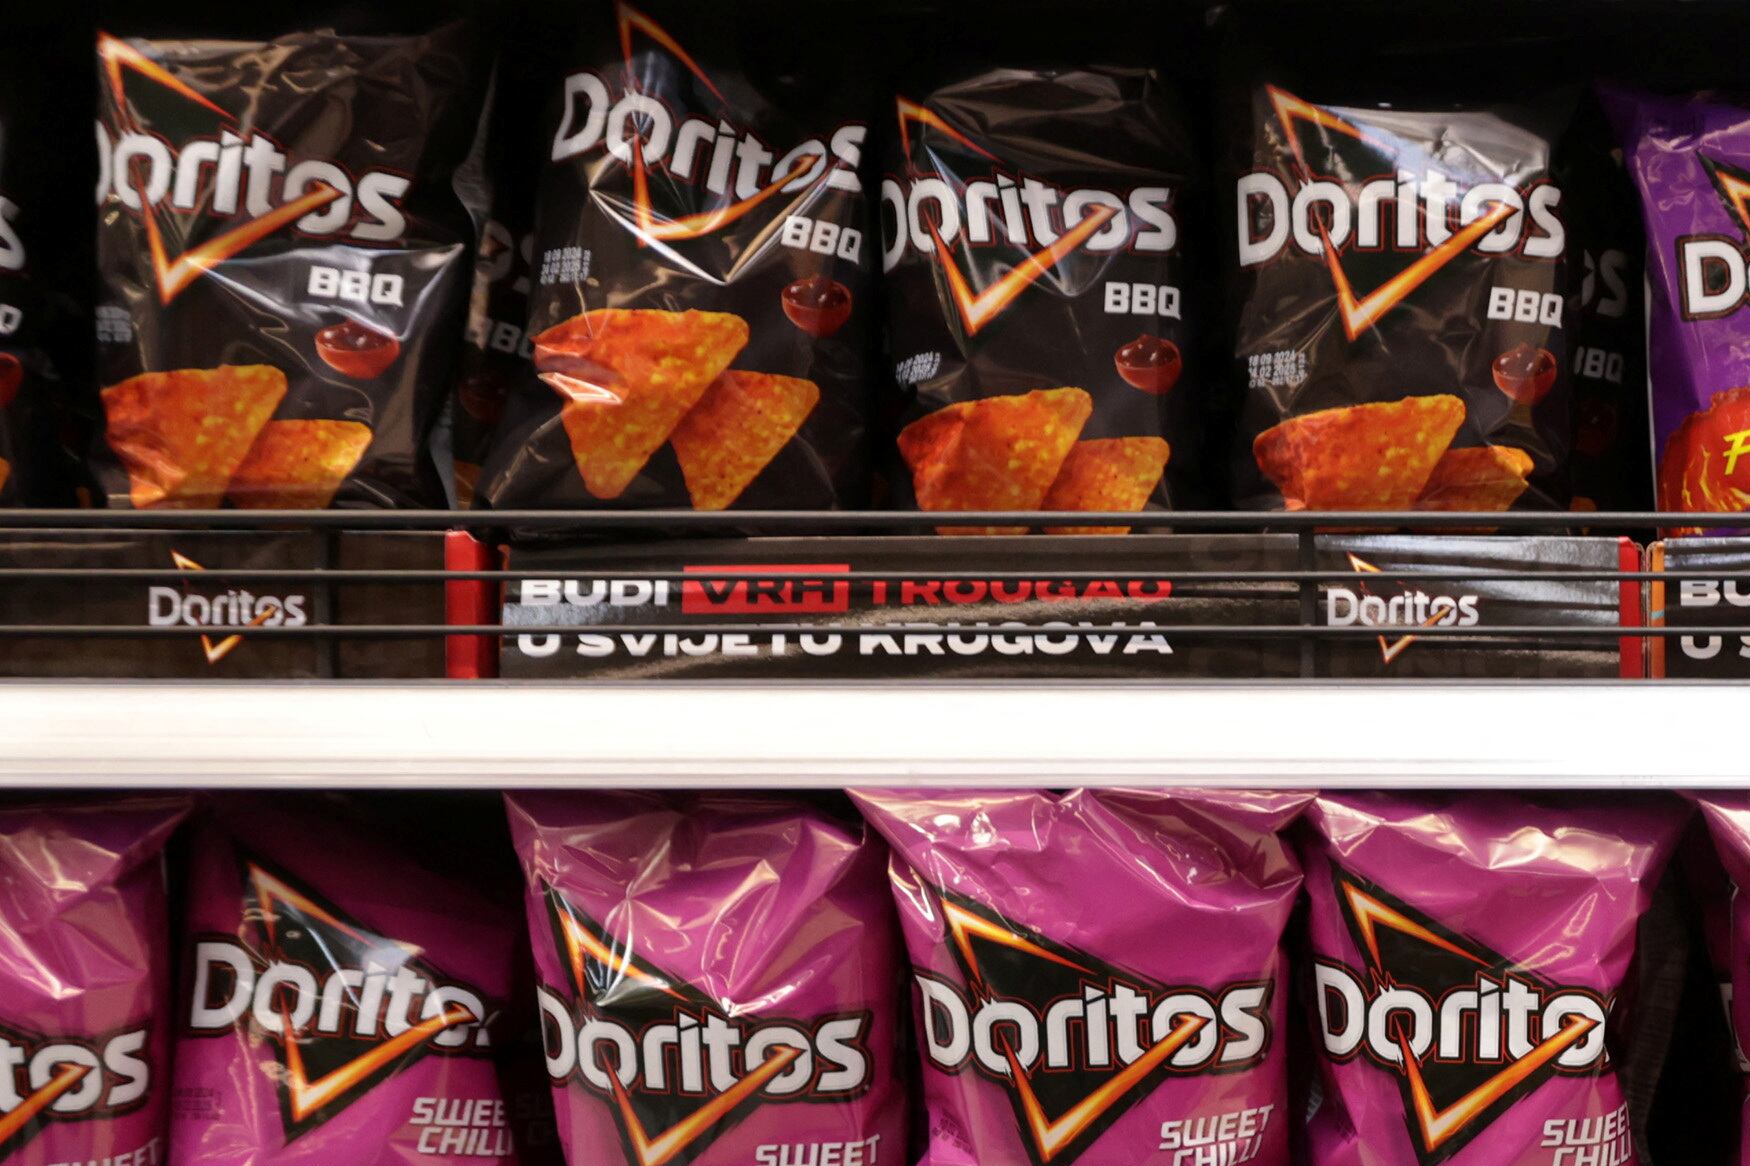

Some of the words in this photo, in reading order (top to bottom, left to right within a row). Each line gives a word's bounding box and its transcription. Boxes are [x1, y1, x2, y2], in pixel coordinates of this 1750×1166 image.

[552, 70, 867, 197] Doritos
[97, 122, 410, 241] oritos
[1239, 169, 1565, 268] Doritos
[782, 216, 862, 264] BBQ
[309, 266, 404, 306] BBQ
[1105, 283, 1181, 320] BBQ
[1487, 287, 1563, 329] BBQ
[148, 586, 306, 627] Doritos
[520, 578, 668, 606] BUDI
[862, 580, 1172, 604] TROUGAO
[1326, 588, 1478, 627] Doritos
[517, 626, 556, 656] U
[575, 624, 843, 656] SVIJETU
[859, 621, 1174, 655] KRUGOVA
[1681, 628, 1722, 658] U
[918, 974, 1267, 1073] Doritos
[1315, 963, 1611, 1066] Dorito
[538, 985, 869, 1090] Doritos
[410, 1097, 507, 1127] SWEE
[1159, 1105, 1274, 1149] SWEET
[1542, 1105, 1630, 1148] SWEE
